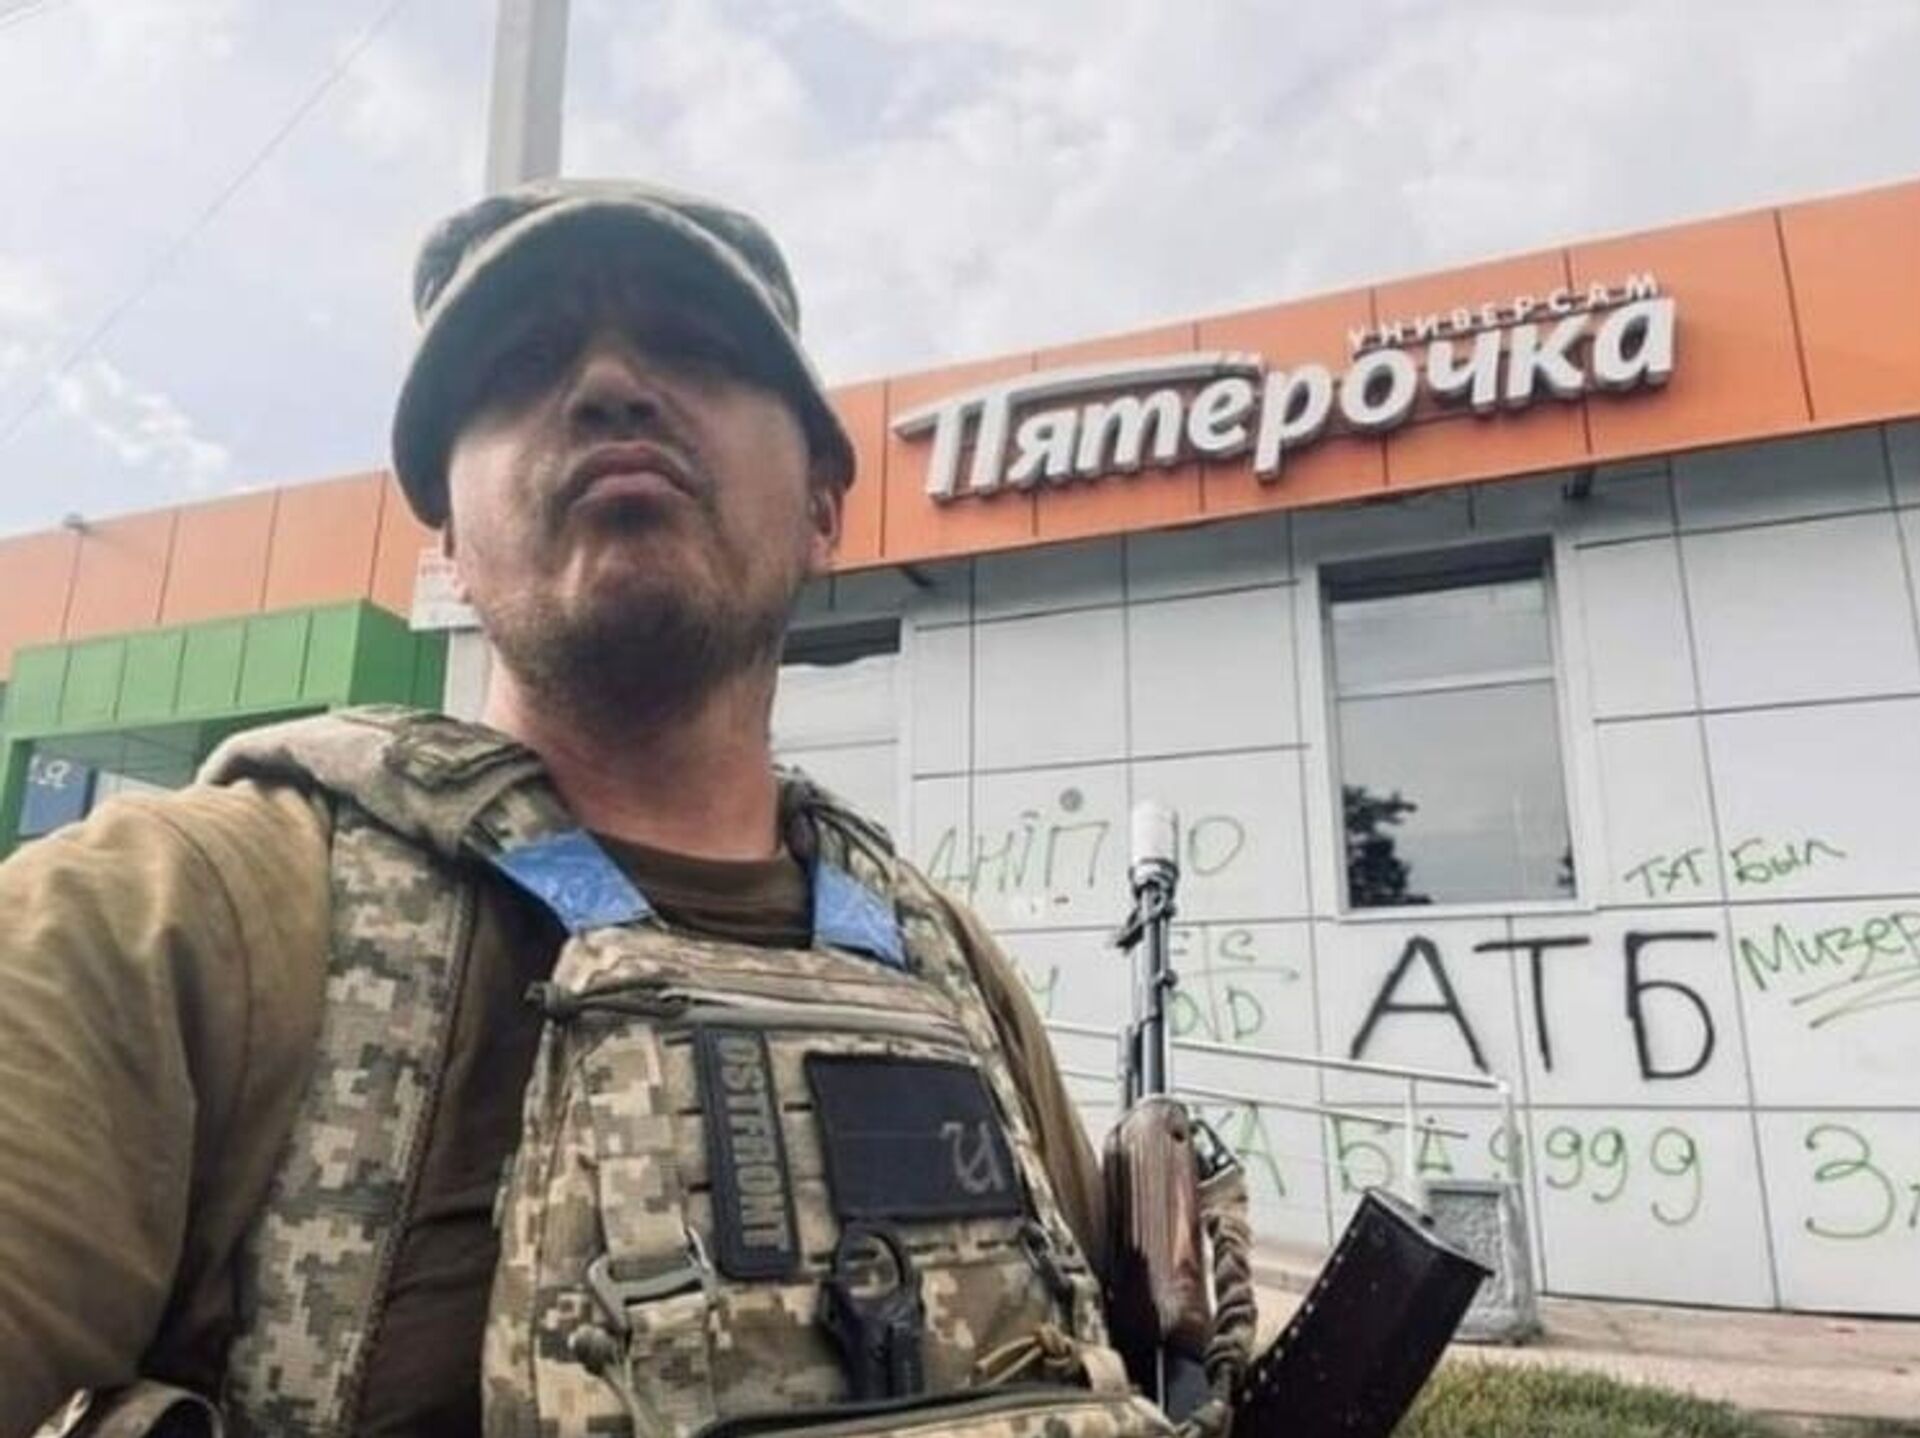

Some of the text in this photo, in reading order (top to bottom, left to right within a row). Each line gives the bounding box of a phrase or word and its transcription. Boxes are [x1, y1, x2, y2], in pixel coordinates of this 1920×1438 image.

[1349, 272, 1660, 347] УНИВЕРСАМ
[1351, 931, 1717, 1080] АТБ
[717, 1036, 790, 1250] OSTFRONT
